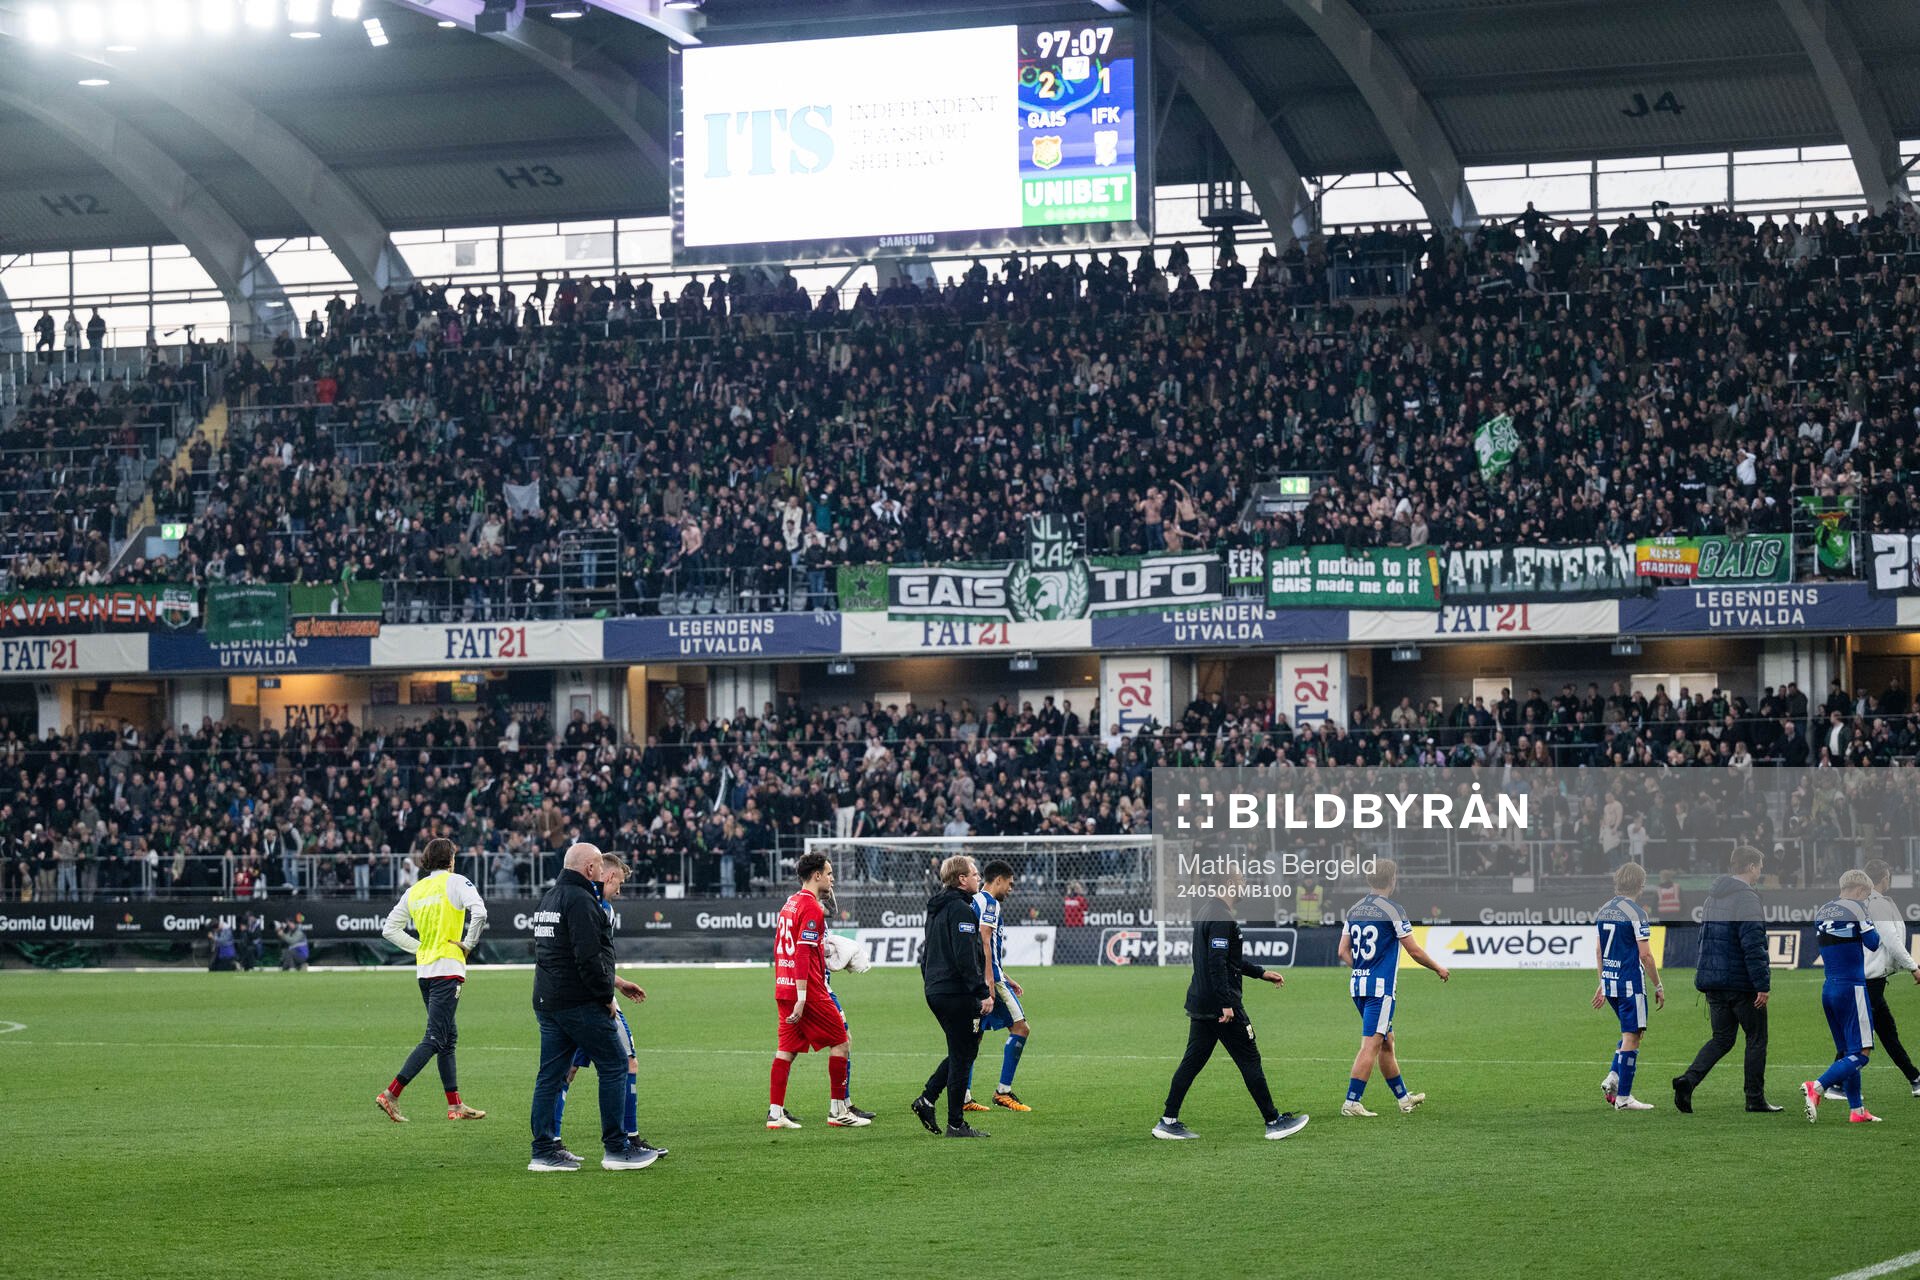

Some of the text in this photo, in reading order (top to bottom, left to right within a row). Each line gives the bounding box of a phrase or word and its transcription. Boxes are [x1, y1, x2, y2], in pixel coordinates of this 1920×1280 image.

[1037, 27, 1113, 58] 97:07
[1038, 71, 1056, 98] 2
[1098, 67, 1110, 94] 1
[1621, 90, 1685, 117] J4
[1027, 111, 1067, 128] GAIS
[1091, 106, 1120, 124] IFK
[704, 105, 834, 178] ITS
[496, 166, 563, 188] H3
[1024, 176, 1129, 207] UNIBET
[40, 194, 109, 216] H2
[879, 234, 935, 248] SAMSUNG
[1272, 556, 1421, 577] ain't nothin to it
[1641, 562, 1692, 575] TRADITION
[1697, 540, 1782, 578] GAIS
[899, 563, 1207, 607] GAIS TIFO
[1272, 577, 1420, 595] GAIS made me do it
[1696, 588, 1818, 608] LEGENDENS
[0, 591, 157, 628] KVARNEN
[1435, 603, 1531, 634] FAT21
[1709, 608, 1805, 627] UTVALDA
[668, 618, 775, 637] LEGENDENS
[920, 620, 1009, 646] FAT21
[1174, 623, 1265, 641] UTVALDA
[445, 626, 529, 659] FAT21
[680, 637, 763, 654] UTVALDA
[2, 638, 79, 671] FAT21
[220, 650, 298, 667] UTVALDA
[51, 915, 94, 931] Ullevi
[696, 912, 752, 929] Gamla
[1479, 907, 1544, 926] Gamla
[1350, 924, 1379, 961] 33
[1476, 930, 1583, 955] weber
[1602, 923, 1616, 958] 7
